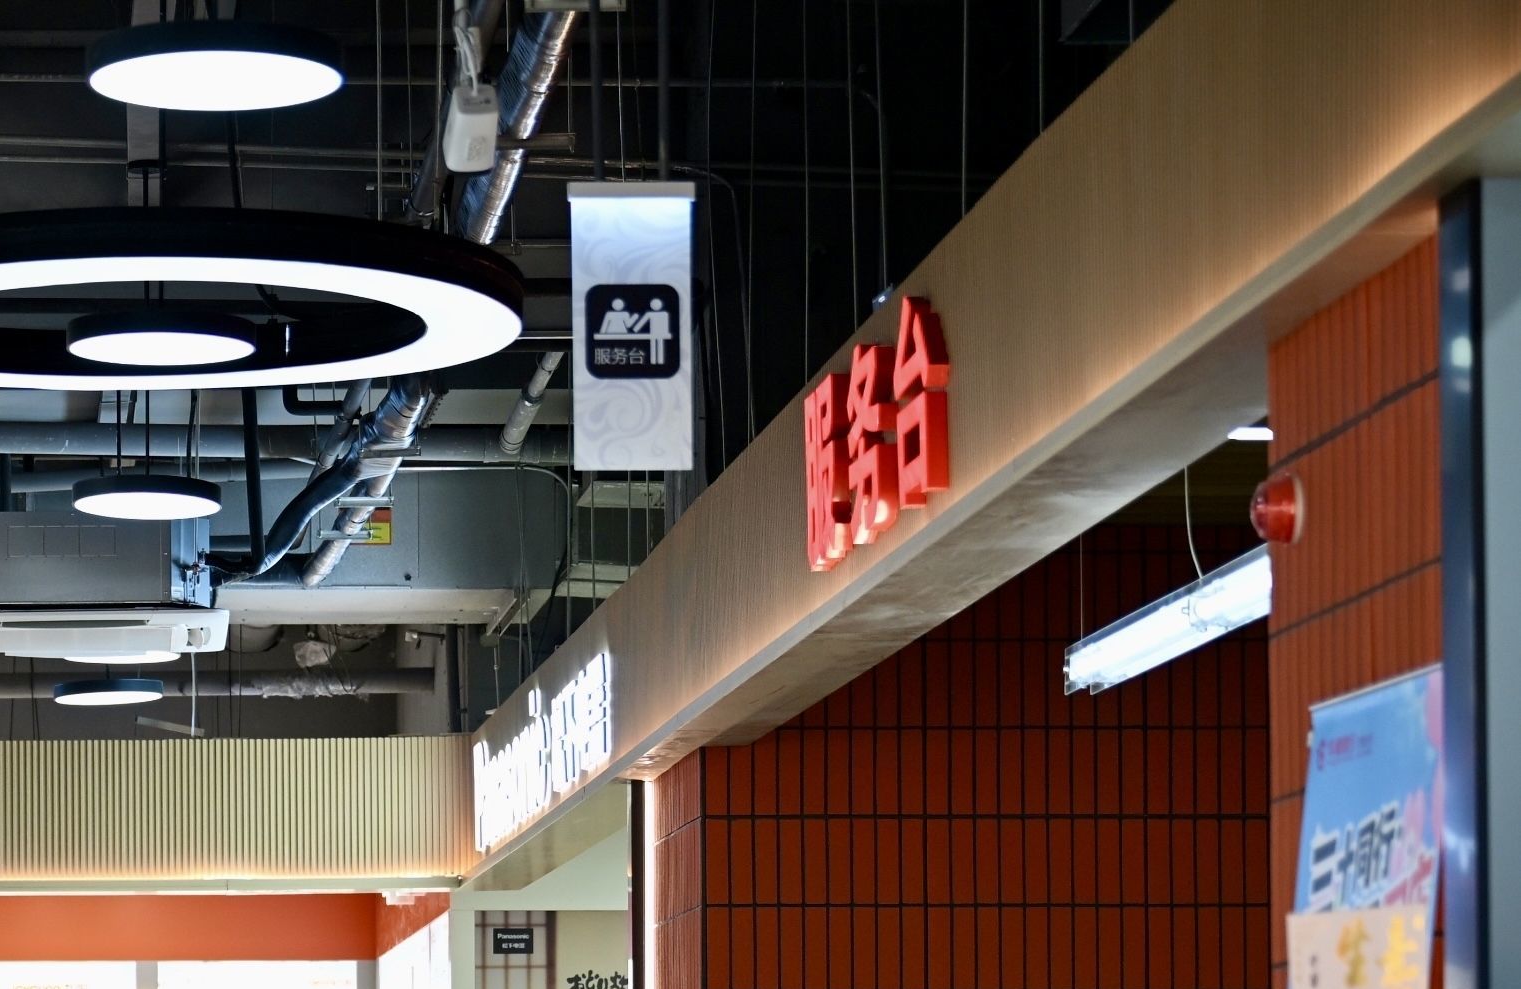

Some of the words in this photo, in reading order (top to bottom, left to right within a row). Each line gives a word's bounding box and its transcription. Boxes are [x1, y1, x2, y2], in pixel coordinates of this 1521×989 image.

[594, 348, 646, 365] 服务台
[804, 296, 949, 571] 服务台
[497, 932, 529, 940] Panasonic
